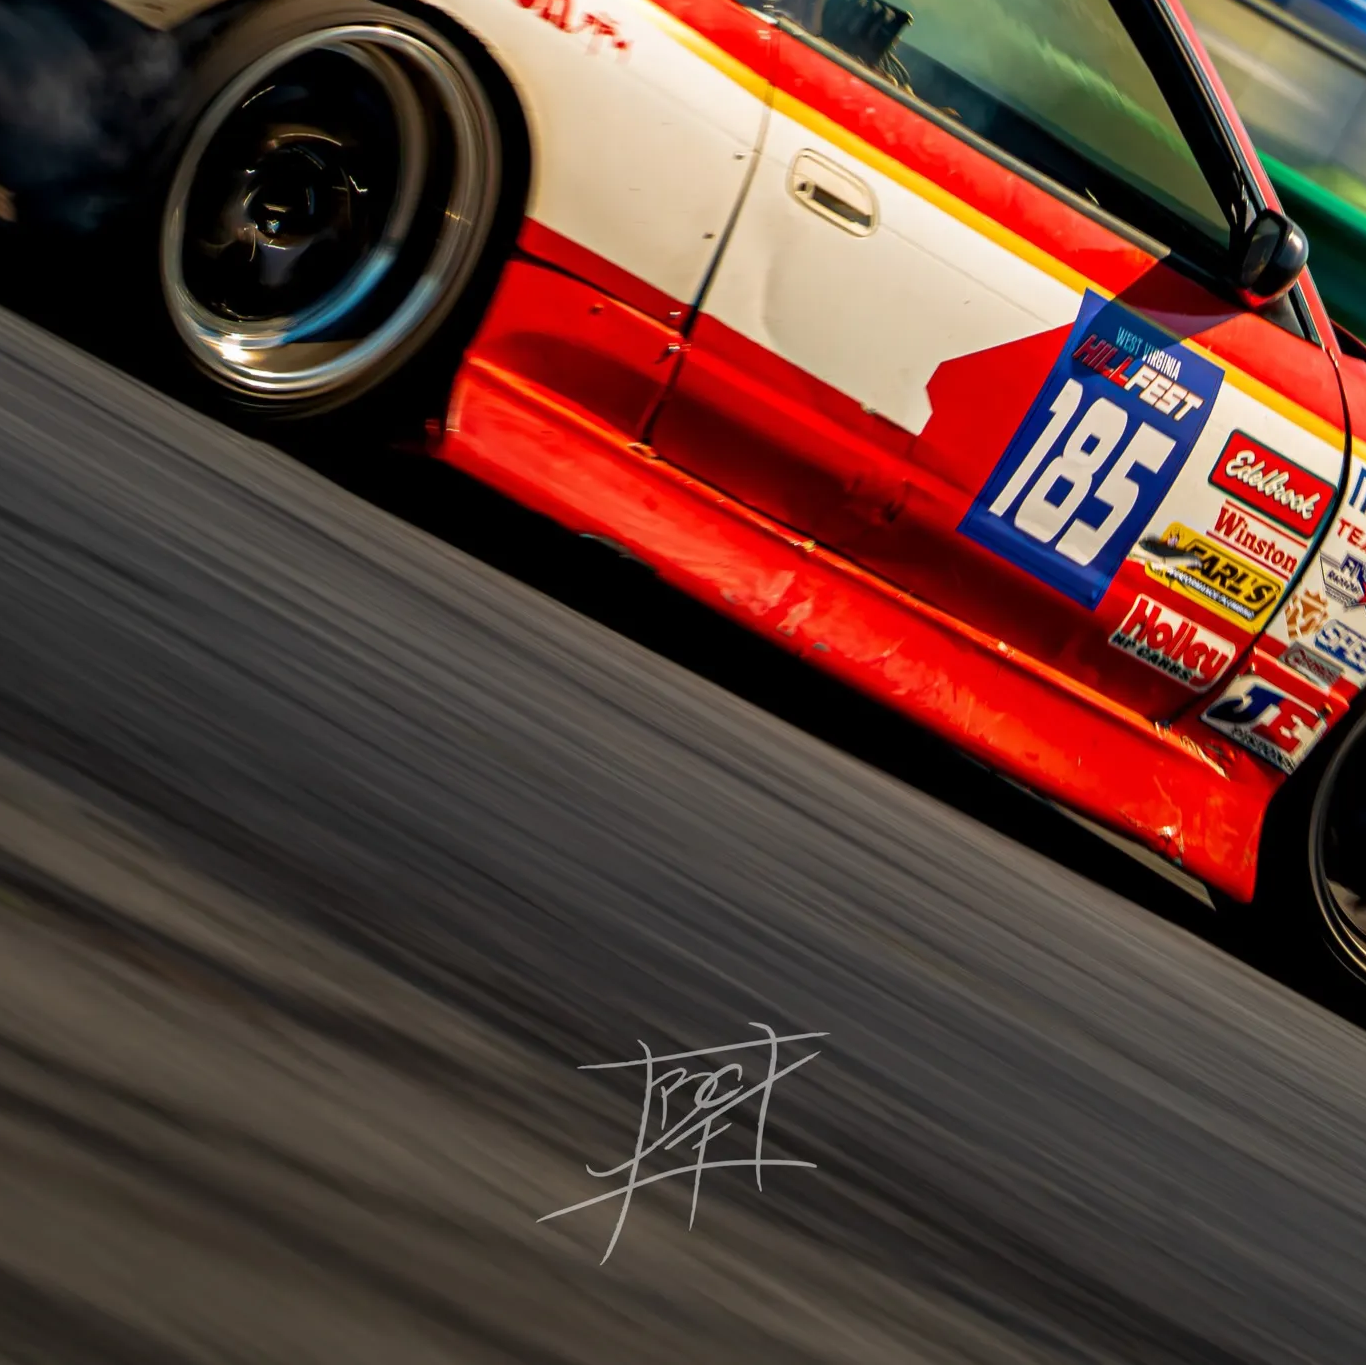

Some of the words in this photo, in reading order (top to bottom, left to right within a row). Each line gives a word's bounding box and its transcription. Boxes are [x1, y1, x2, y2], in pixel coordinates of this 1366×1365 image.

[1115, 326, 1143, 356] WEST
[1142, 341, 1182, 381] VIRGINIA
[988, 378, 1177, 567] 185
[1226, 450, 1321, 520] Edelbrock
[1214, 506, 1298, 574] Winston
[1121, 597, 1229, 686] Holley
[1206, 683, 1321, 755] JE
